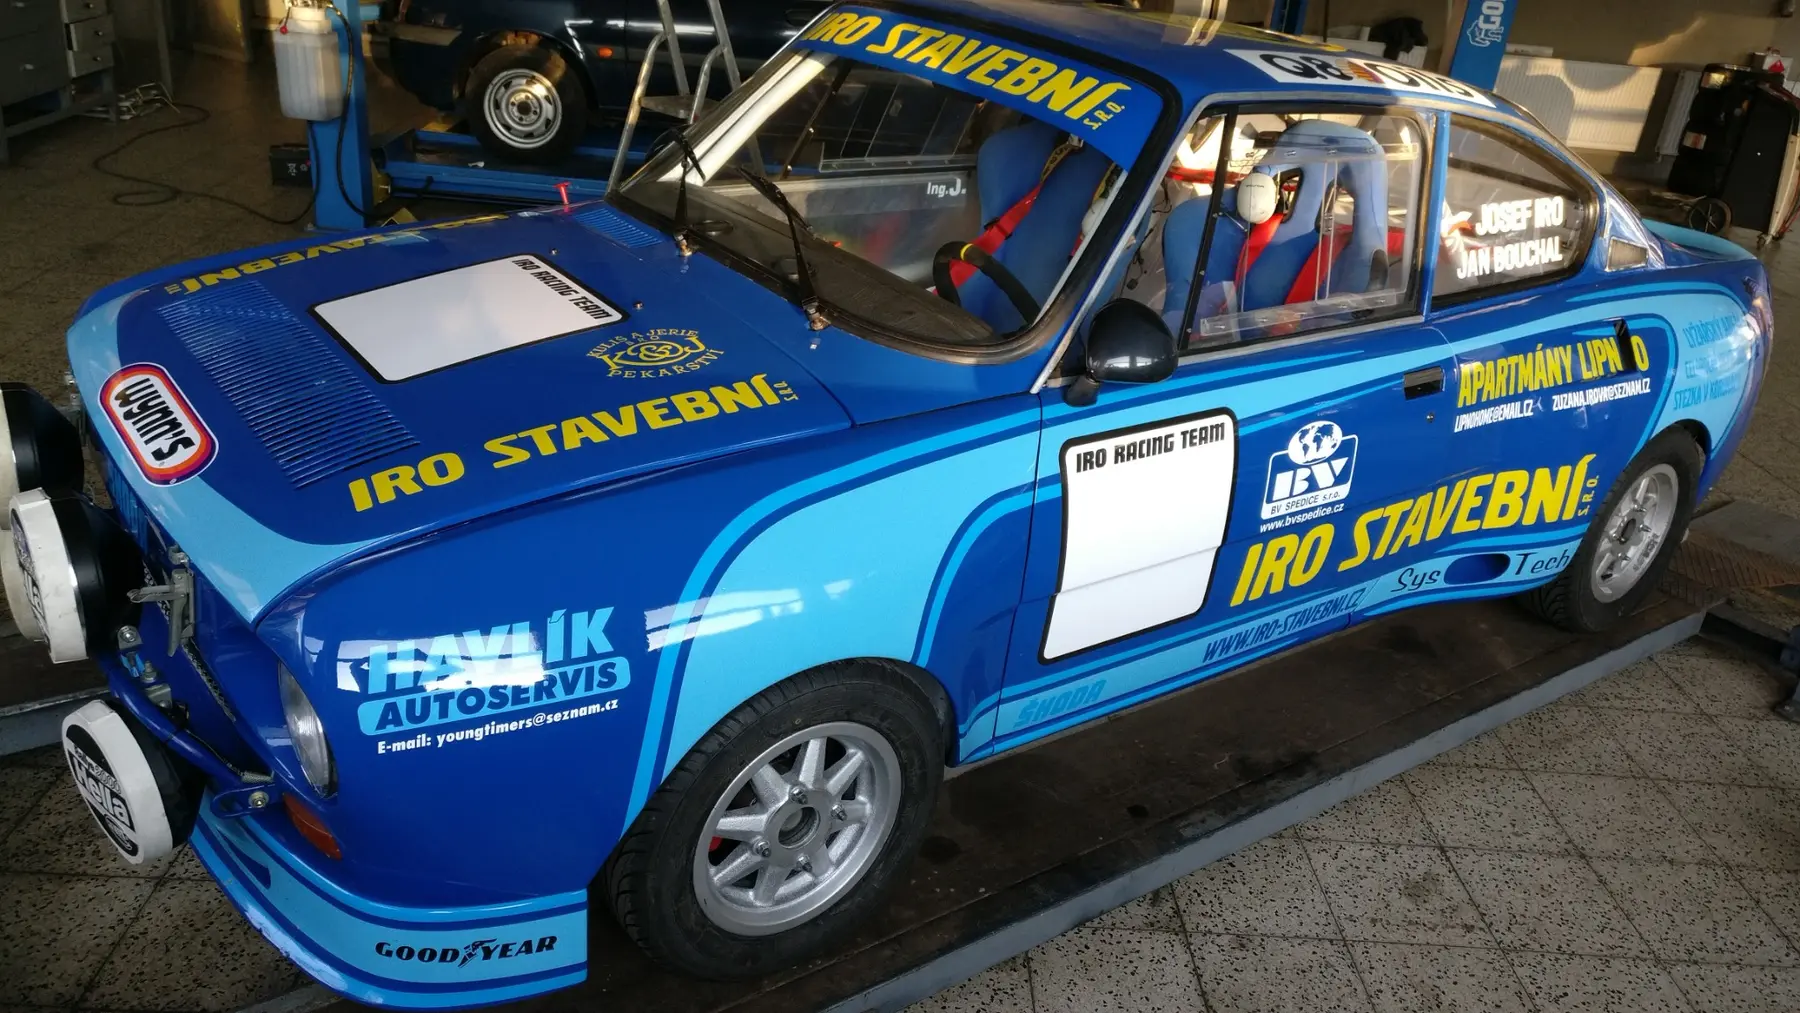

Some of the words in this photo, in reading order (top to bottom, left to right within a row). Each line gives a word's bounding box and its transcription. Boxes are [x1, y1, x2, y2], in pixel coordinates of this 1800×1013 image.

[801, 12, 882, 45] IRO
[866, 23, 1132, 120] STAVEBNÍ
[1475, 199, 1534, 236] JOSEF
[1534, 196, 1564, 228] IRO
[1457, 246, 1491, 279] JAN
[1493, 236, 1563, 273] BOUCHAL
[511, 258, 542, 271] IRO
[529, 270, 580, 297] RACING
[568, 296, 614, 320] TEAM
[1456, 343, 1573, 408] APARTMÁNY
[348, 452, 465, 513] IRO
[483, 373, 780, 469] STAVEBNÍ
[1076, 447, 1107, 473] IRO
[1113, 432, 1175, 465] RACING
[1181, 422, 1225, 449] TEAM
[1270, 504, 1282, 515] BV
[1285, 494, 1320, 511] SPEDICE
[1272, 457, 1349, 501] BV
[1229, 523, 1335, 607] IRO
[1338, 453, 1597, 572] STAVEBNÍ
[1260, 503, 1345, 533] www.bvspedice.cz
[1514, 549, 1571, 576] Tech
[367, 606, 616, 695] HAVLÍK
[1202, 587, 1367, 663] WWW.IRO-STAVEBNI.CZ
[375, 661, 618, 731] AUTOSERVIS
[377, 730, 433, 755] E-mail:
[436, 699, 619, 748] youngtimers@seznam.cz
[73, 756, 133, 831] Hella
